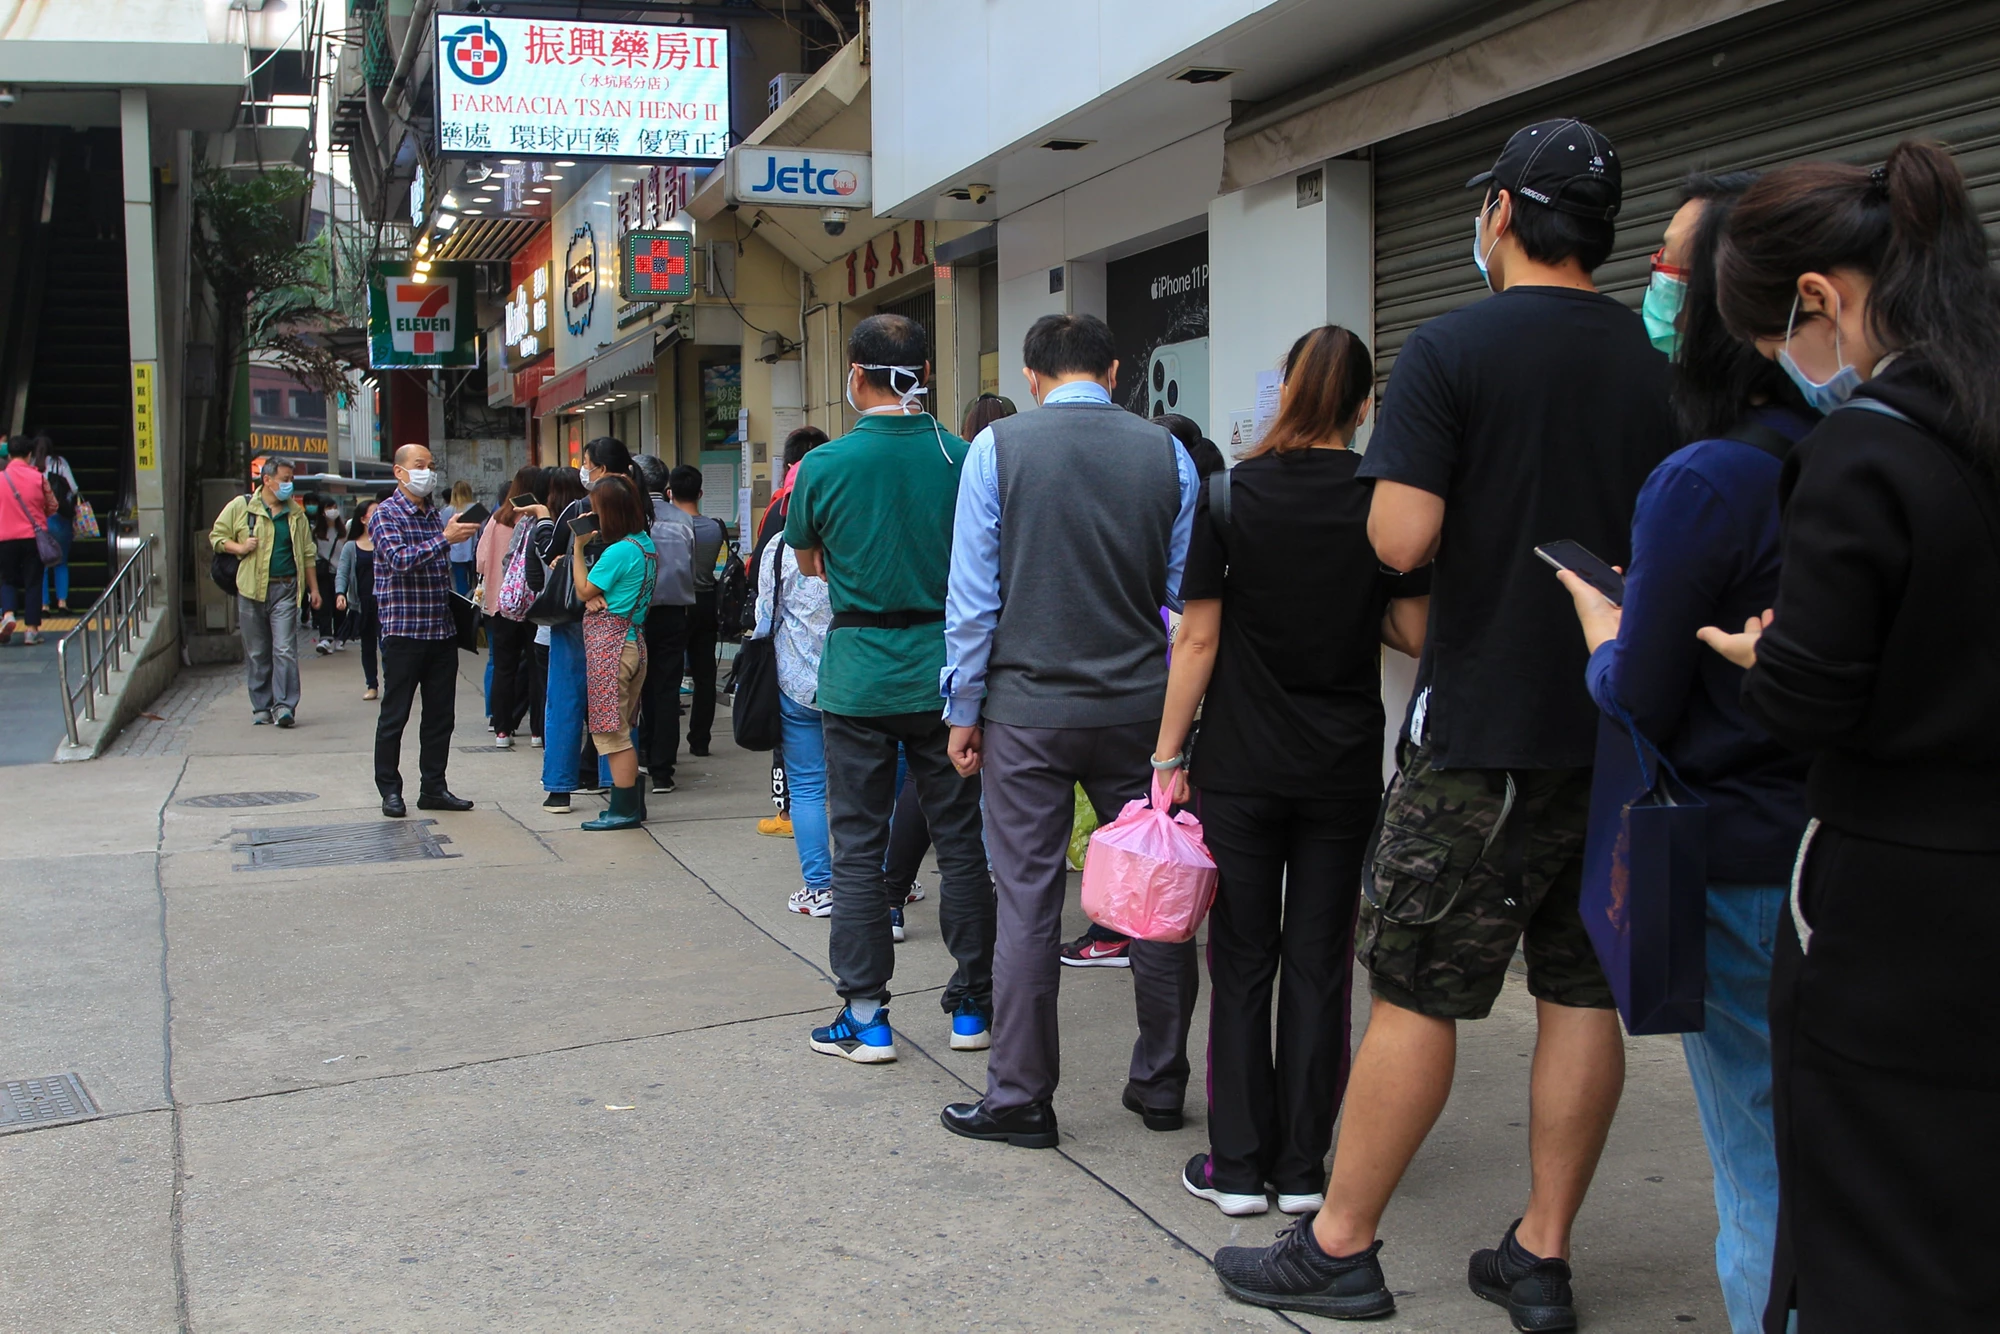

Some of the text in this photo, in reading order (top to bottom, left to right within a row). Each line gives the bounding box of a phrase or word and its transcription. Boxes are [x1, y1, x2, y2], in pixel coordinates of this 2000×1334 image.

[524, 25, 719, 70] 振興藥房II
[451, 93, 718, 121] FARMACIA TSAN HENG II
[509, 125, 619, 152] 環球西藥
[1520, 186, 1551, 204] DODGERS
[1158, 275, 1191, 298] iPhone
[1192, 266, 1200, 288] 11
[262, 434, 299, 451] DELTA
[303, 437, 328, 453] ASIA
